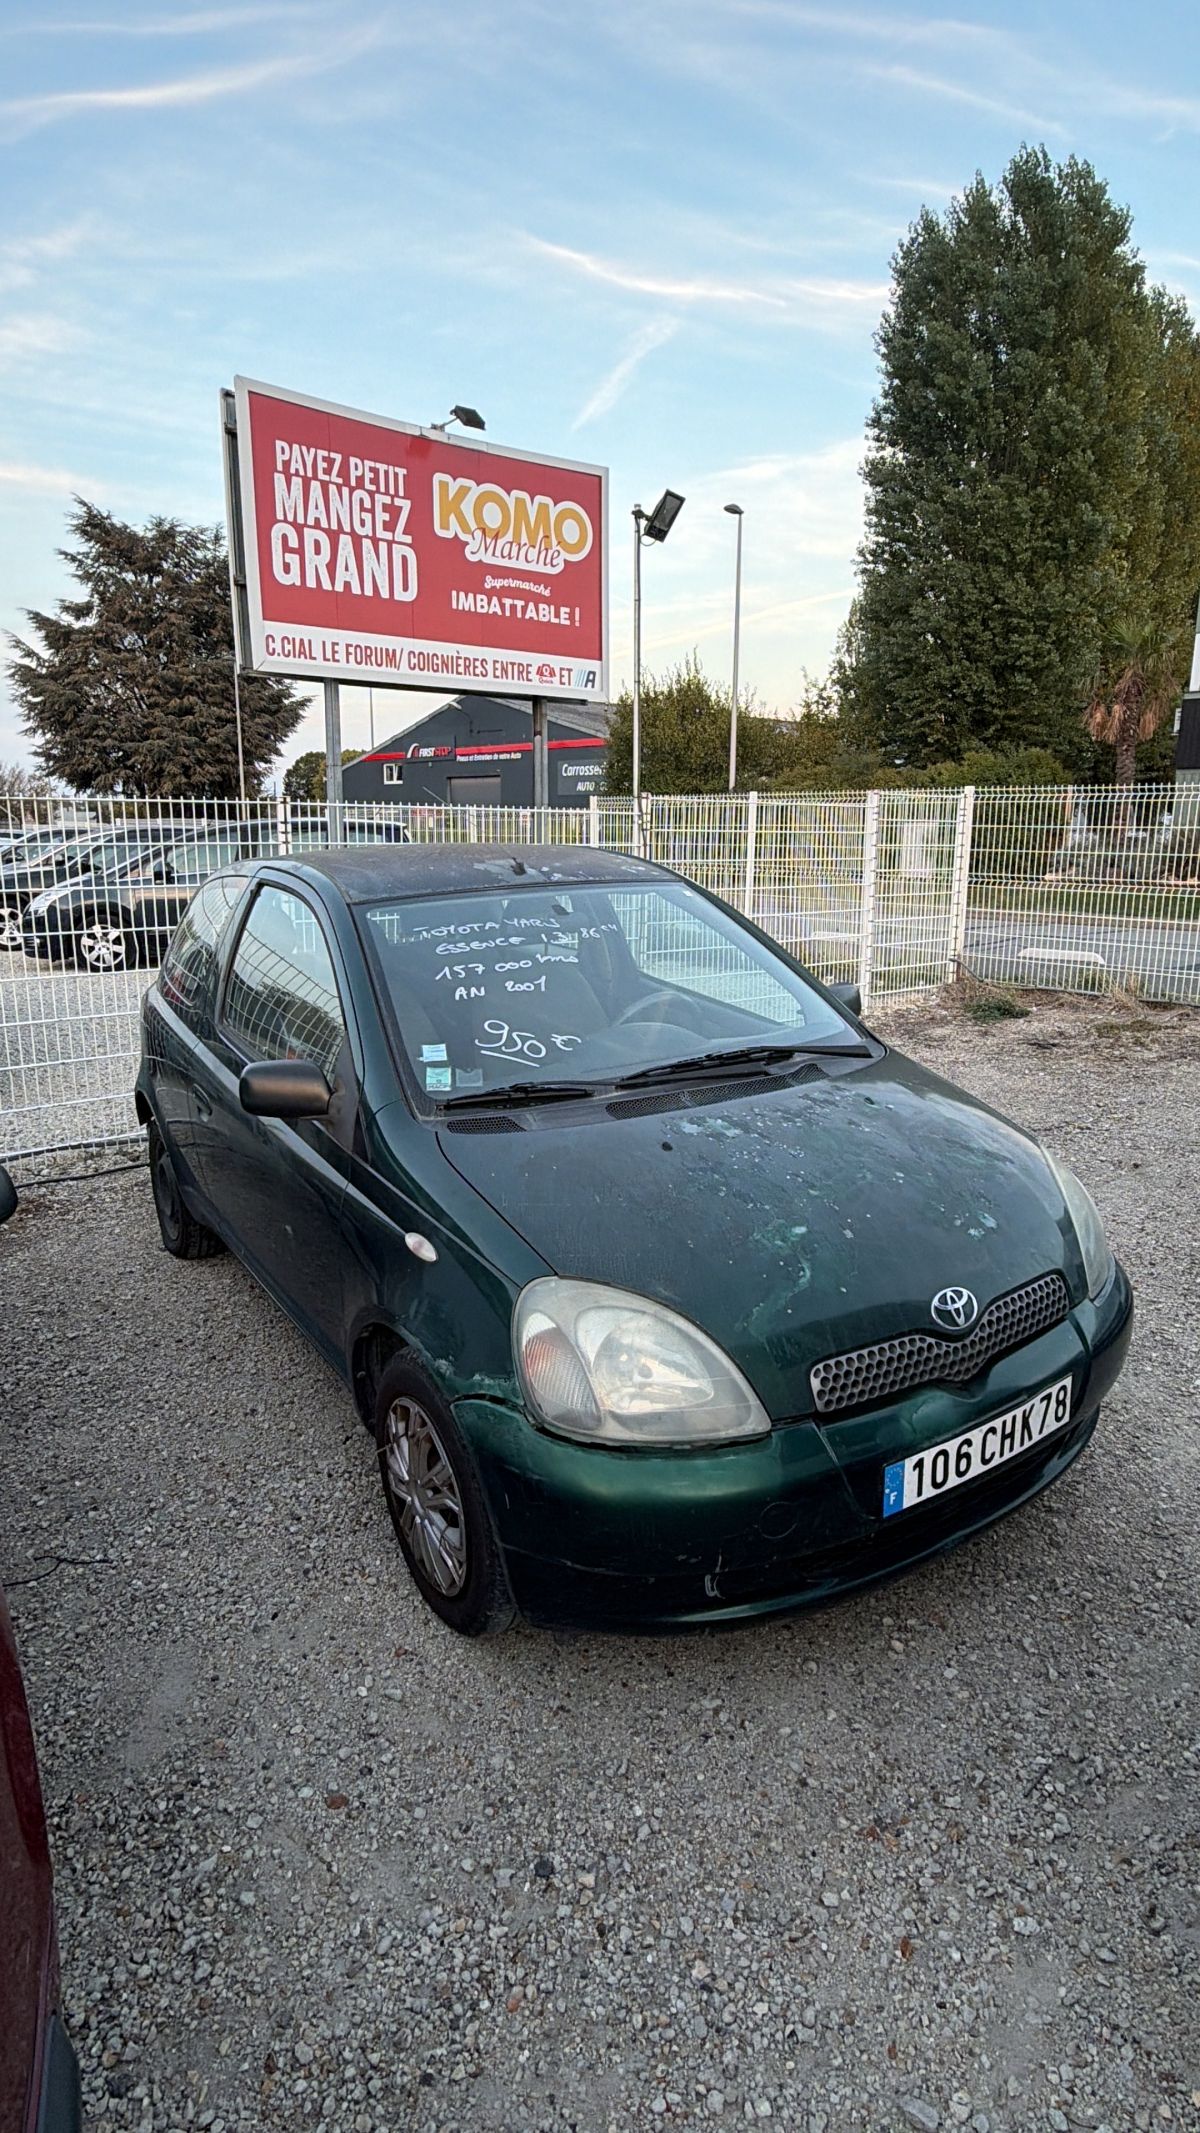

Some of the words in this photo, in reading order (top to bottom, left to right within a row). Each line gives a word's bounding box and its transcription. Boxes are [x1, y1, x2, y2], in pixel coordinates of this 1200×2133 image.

[275, 440, 343, 484] PAYEZ
[349, 456, 407, 496] PETIT
[274, 472, 412, 543] MANGEZ
[437, 478, 590, 556] KOMO
[470, 526, 562, 568] Marché
[271, 522, 418, 602] GRAND
[484, 575, 551, 597] Supermarché
[265, 634, 317, 660] C.CIAL
[322, 640, 340, 662] LE
[407, 650, 489, 678] COIGNIÈRES
[492, 660, 533, 682] ENTRE
[560, 667, 573, 686] ET
[576, 781, 596, 792] AUTO
[413, 921, 500, 937] TOYOTA
[503, 917, 561, 928] YARIS
[435, 936, 526, 955] ESSENCE
[435, 963, 486, 980] 157
[455, 986, 486, 1000] AN
[504, 975, 547, 992] 2001
[889, 1491, 898, 1505] F
